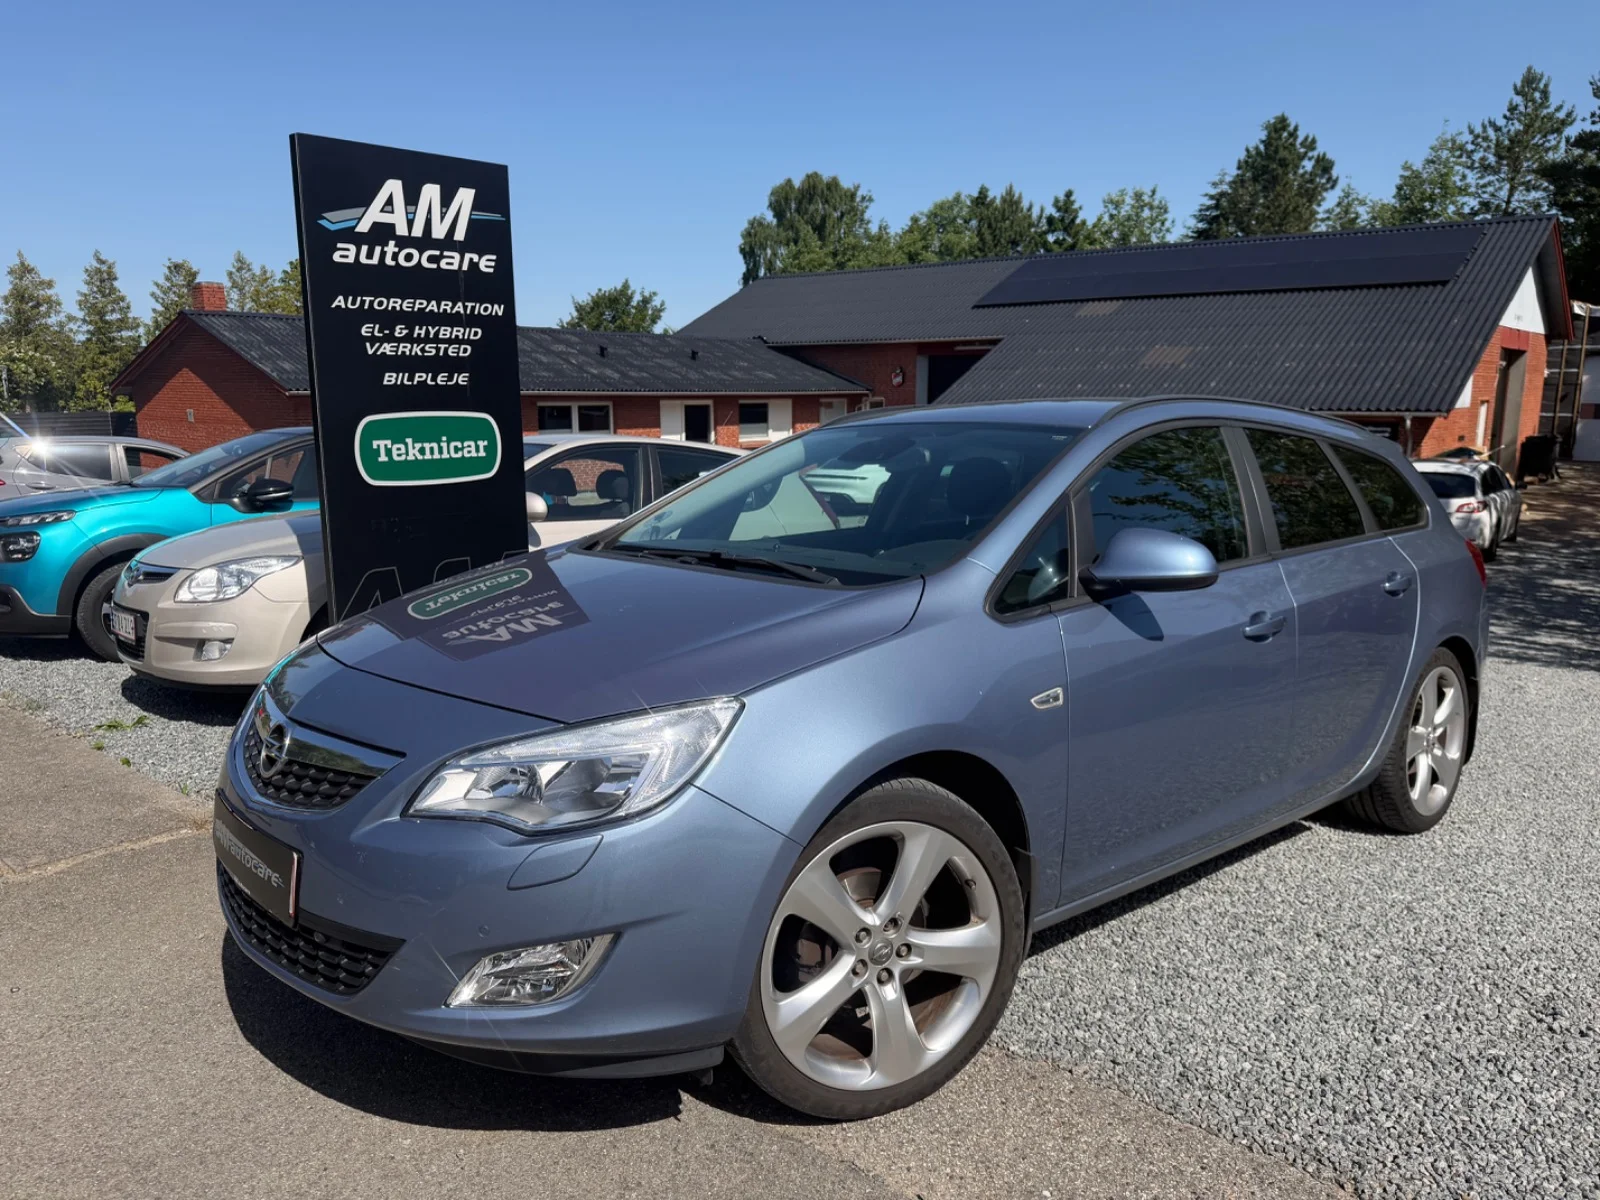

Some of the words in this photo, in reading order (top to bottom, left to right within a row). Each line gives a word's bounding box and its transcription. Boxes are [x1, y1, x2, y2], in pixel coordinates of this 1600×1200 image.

[354, 179, 476, 241] AM
[332, 240, 497, 273] autocare
[331, 295, 505, 316] AUTOREPARATION
[361, 323, 390, 337] EL-
[394, 325, 409, 337] &
[413, 325, 482, 340] HYBRID
[365, 342, 472, 357] VÆRKSTED
[383, 372, 470, 385] BILPLEJE
[372, 436, 488, 462] Teknicar
